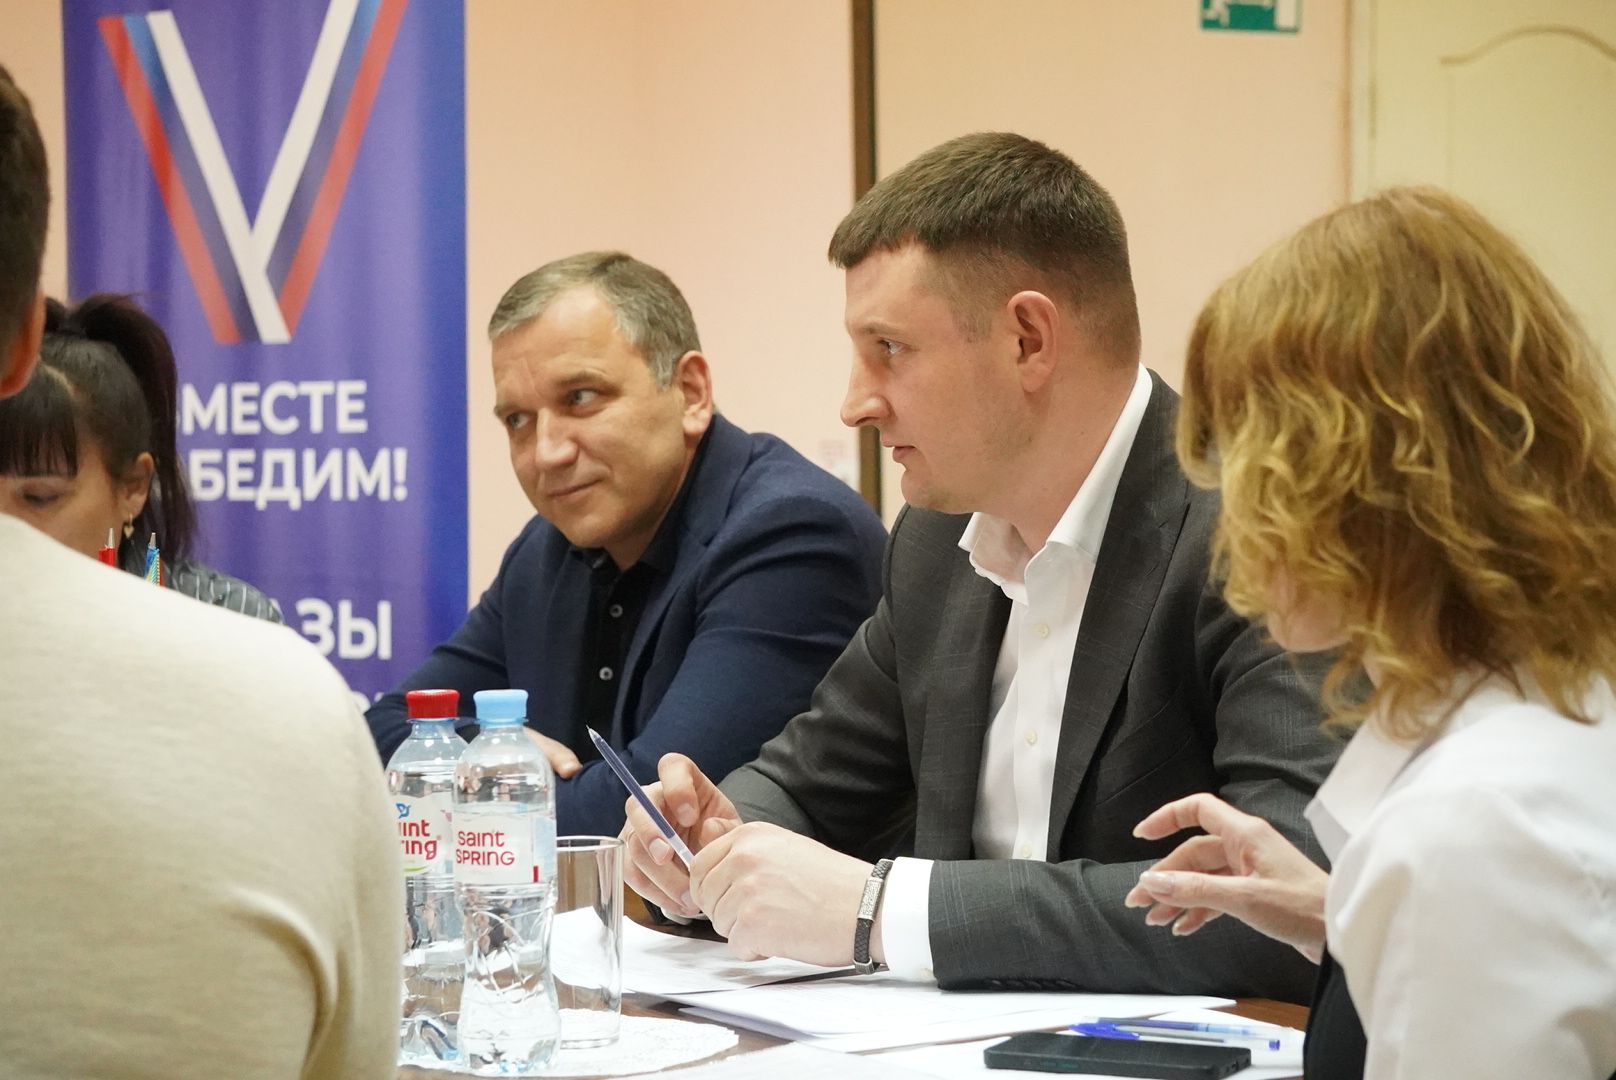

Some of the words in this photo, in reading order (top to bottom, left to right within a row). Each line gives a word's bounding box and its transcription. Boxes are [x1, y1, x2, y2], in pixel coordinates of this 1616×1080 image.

[176, 380, 368, 435] МЕСТЕ
[189, 448, 408, 510] БЕДИМ!
[270, 598, 392, 660] ЗЫ
[398, 819, 431, 837] int
[401, 840, 438, 861] ing
